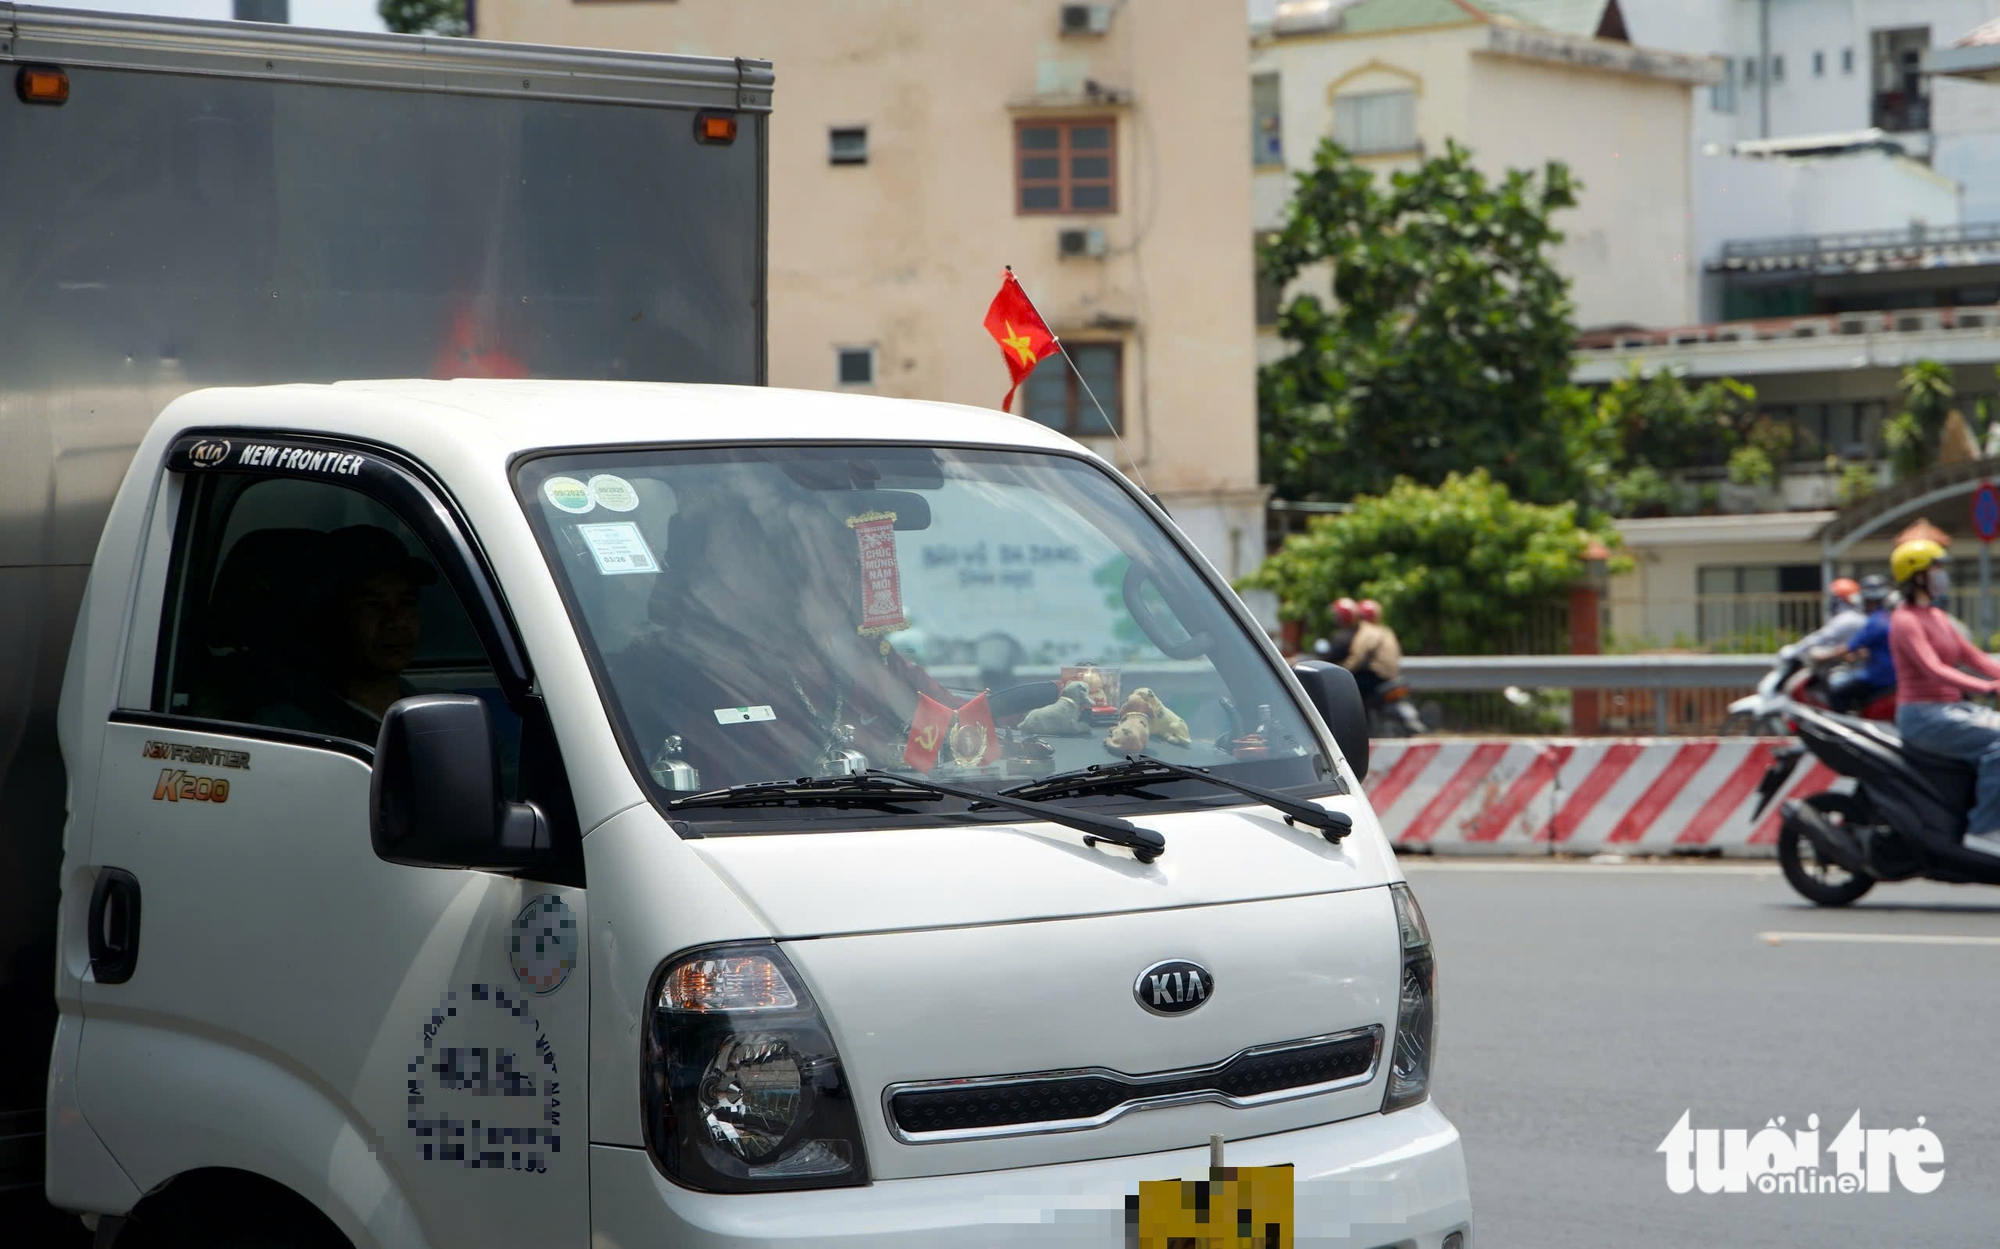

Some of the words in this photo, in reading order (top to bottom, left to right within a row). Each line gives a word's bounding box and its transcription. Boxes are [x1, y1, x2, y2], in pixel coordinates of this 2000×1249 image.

[239, 444, 279, 467] NEW
[276, 448, 365, 476] FRONTIER
[142, 741, 172, 759] NEW
[170, 743, 251, 769] FRONTIER
[153, 768, 230, 803] K200
[1149, 970, 1206, 1005] KIA
